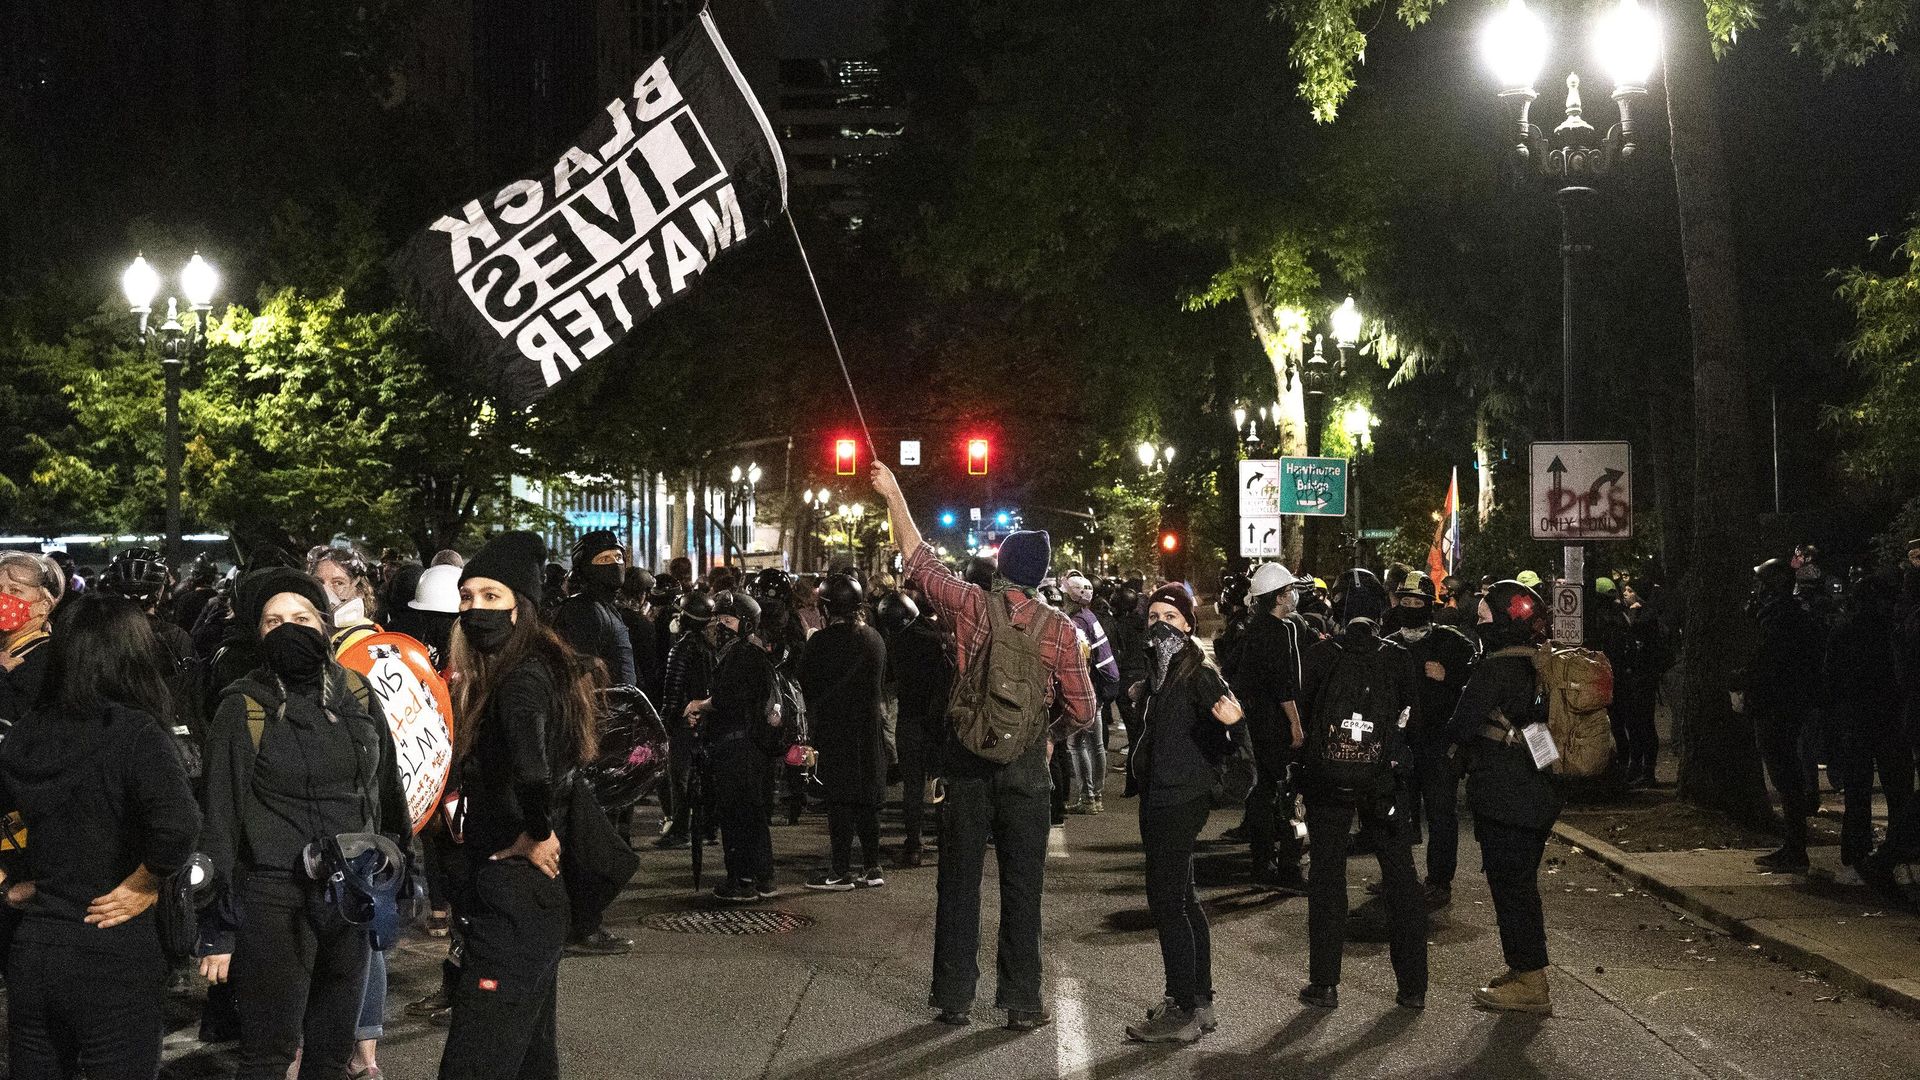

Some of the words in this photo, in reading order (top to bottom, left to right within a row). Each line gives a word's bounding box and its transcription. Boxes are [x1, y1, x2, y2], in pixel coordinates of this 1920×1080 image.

[1286, 463, 1341, 476] Hawthorne
[1297, 479, 1329, 494] Bridge
[1541, 518, 1575, 531] ONLY
[1562, 620, 1576, 629] THIS
[1557, 630, 1580, 640] BLOCK
[391, 687, 422, 741] ted
[400, 739, 408, 748] 4
[398, 727, 438, 793] BLM
